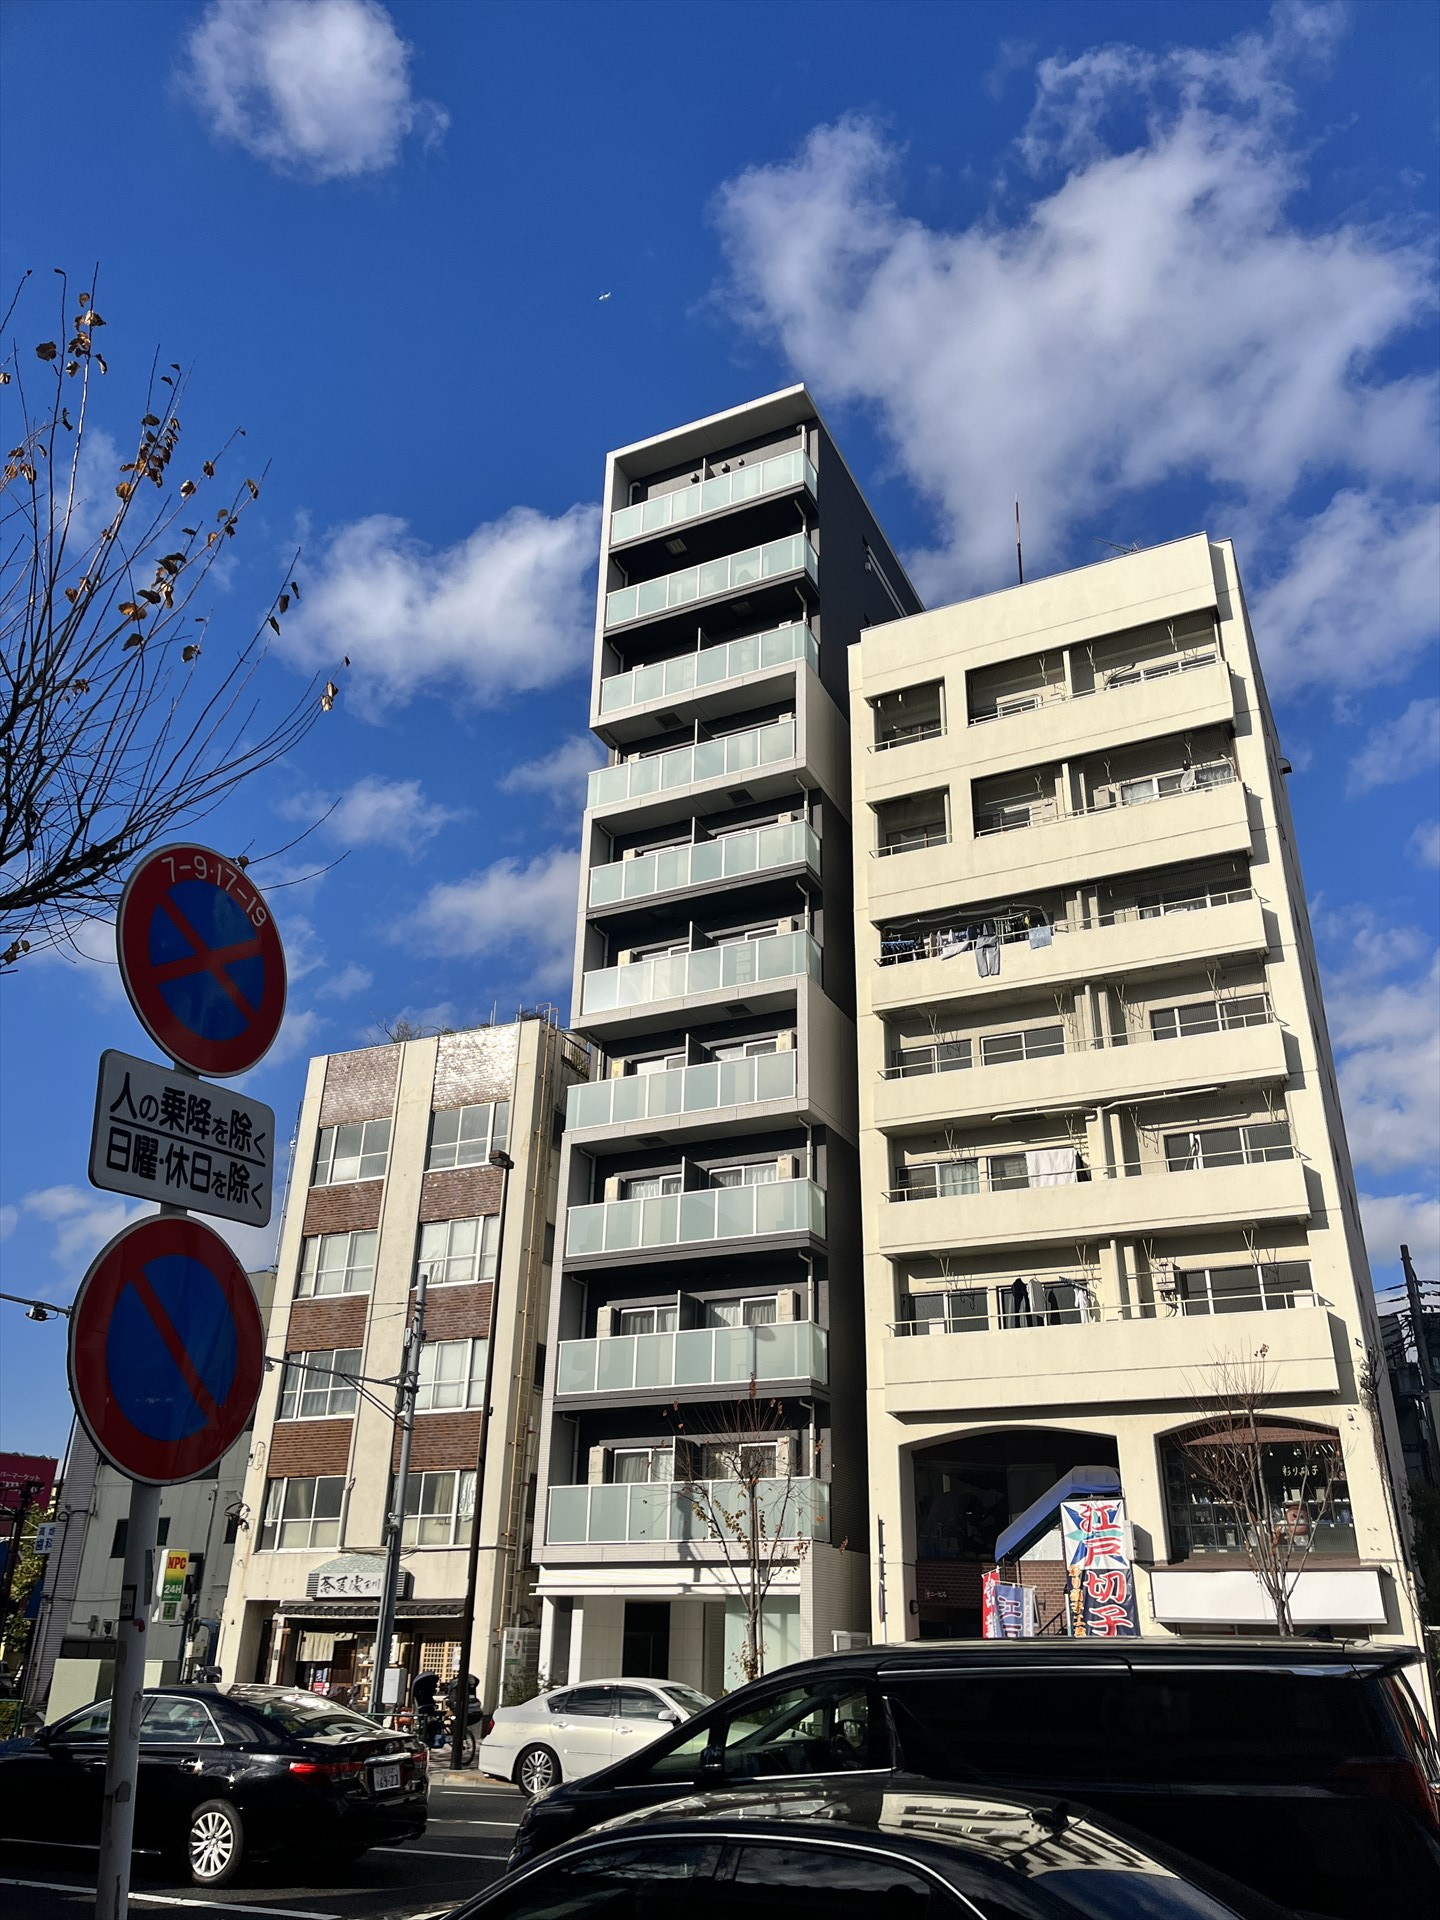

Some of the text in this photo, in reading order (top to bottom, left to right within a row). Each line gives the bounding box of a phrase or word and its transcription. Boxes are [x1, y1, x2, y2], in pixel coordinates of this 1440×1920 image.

[109, 1070, 268, 1161] 人の乗降を除く
[105, 1129, 265, 1211] 日曜・休日を除く
[164, 1584, 182, 1594] 24H
[167, 1556, 187, 1569] NPC
[1079, 1502, 1135, 1637] 江戸切子
